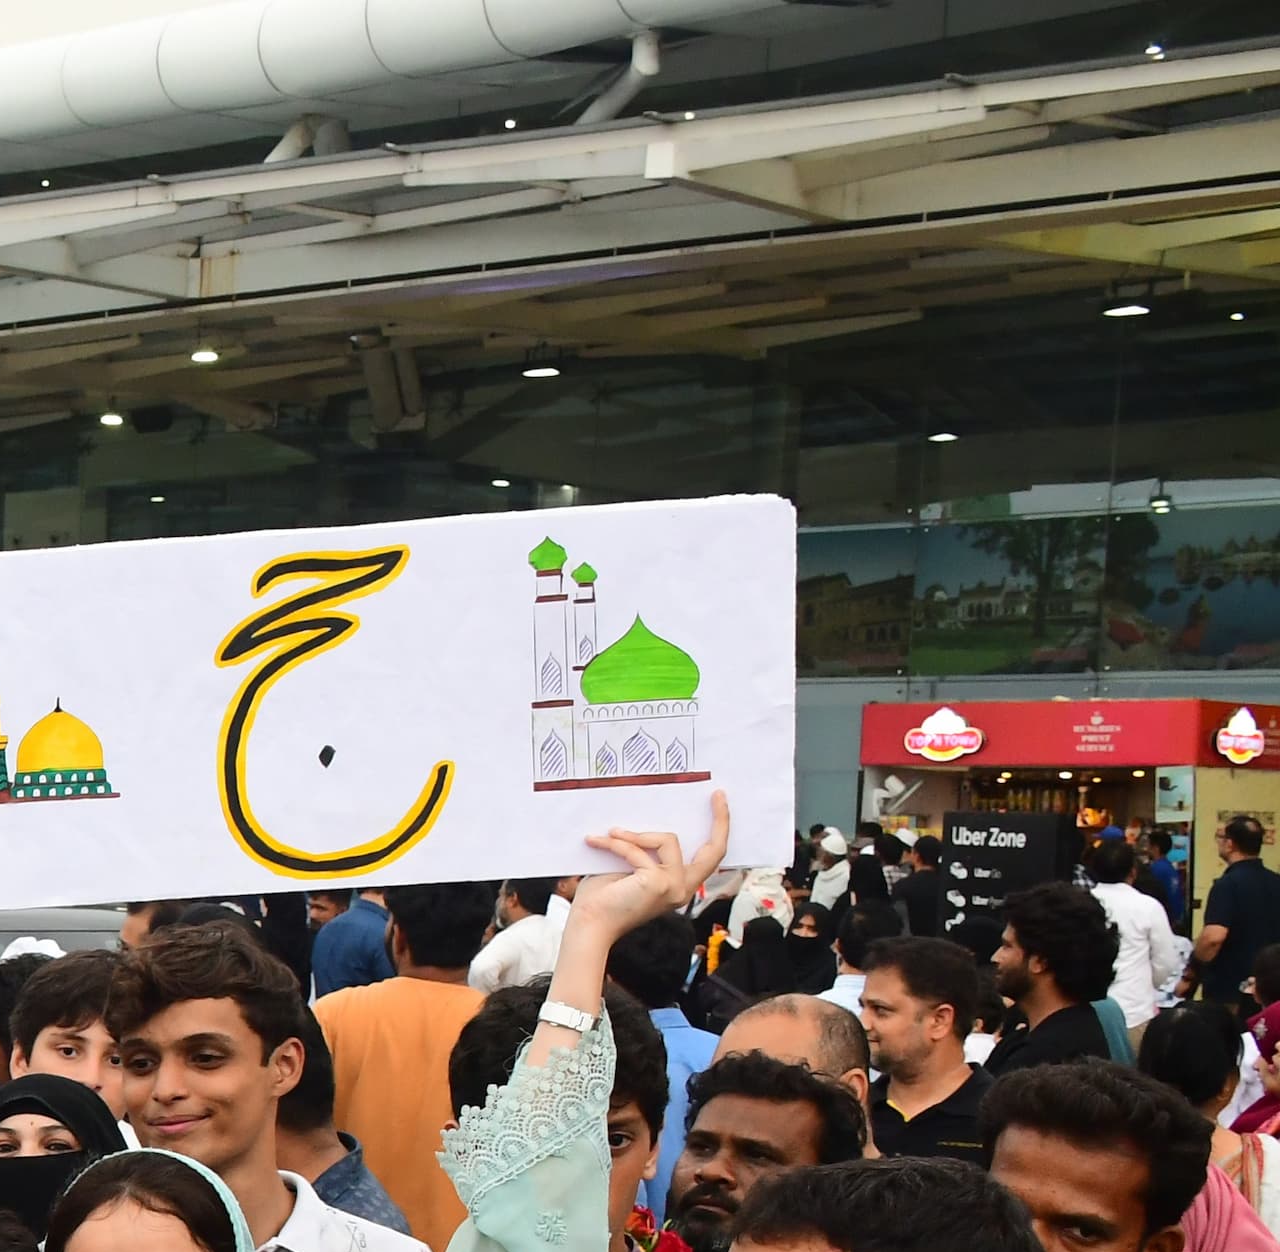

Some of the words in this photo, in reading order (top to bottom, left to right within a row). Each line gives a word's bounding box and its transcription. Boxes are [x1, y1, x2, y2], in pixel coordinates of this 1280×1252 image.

[952, 826, 987, 846] Uber
[988, 827, 1027, 848] Zone
[974, 867, 991, 878] Uber
